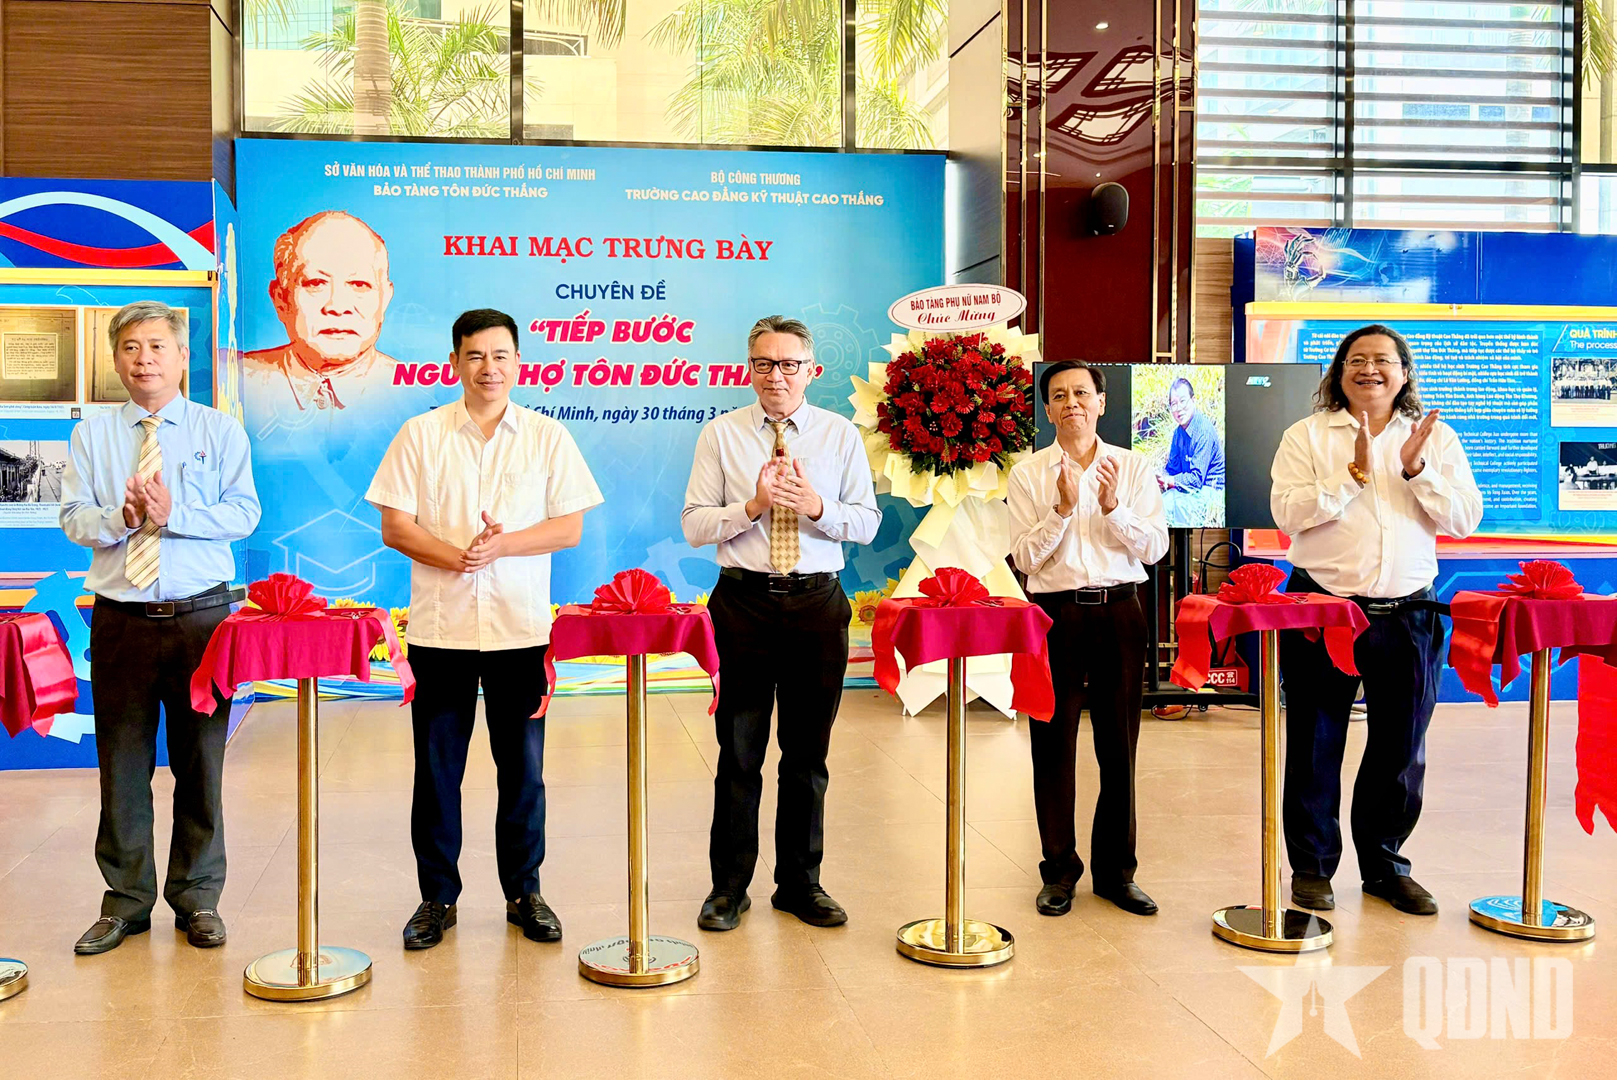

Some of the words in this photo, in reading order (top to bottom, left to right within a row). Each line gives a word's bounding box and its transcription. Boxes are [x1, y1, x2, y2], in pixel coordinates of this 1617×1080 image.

[324, 161, 341, 177] SỞ
[342, 163, 365, 178] VĂN
[368, 163, 391, 178] HÓA
[393, 163, 408, 178] VÀ
[410, 161, 432, 178] THỂ
[433, 166, 461, 179] THAO
[464, 164, 500, 180] THÀNH
[502, 163, 525, 180] PHỐ
[527, 163, 543, 180] HỒ
[545, 166, 564, 180] CHÍ
[566, 168, 596, 181] MINH
[710, 169, 725, 185] BỘ
[728, 169, 757, 185] CÔNG
[759, 172, 801, 186] THƯƠNG
[373, 182, 401, 196] BẢO
[403, 182, 440, 197] TÀNG
[441, 184, 470, 197] TÔN
[471, 183, 501, 198] ĐỨC
[503, 182, 548, 199] THẮNG
[625, 186, 679, 201] TRƯỜNG
[681, 189, 710, 202] CAO
[712, 186, 749, 203] ĐẲNG
[751, 188, 770, 203] KỸ
[771, 191, 809, 207] THUẬT
[811, 193, 840, 205] CAO
[841, 190, 884, 206] THẮNG
[443, 235, 519, 257] KHAI
[528, 236, 595, 264] MẠC
[602, 234, 706, 260] TRƯNG
[715, 233, 774, 261] BÀY
[555, 280, 634, 300] CHUYÊN
[640, 279, 666, 300] ĐỀ
[973, 294, 989, 305] NAM
[529, 309, 606, 343] “TIẾP
[611, 315, 694, 344] BƯỚC
[917, 312, 951, 325] Chúc
[1570, 340, 1585, 349] The
[517, 359, 566, 393] HỢ
[572, 358, 637, 387] TÔN
[640, 357, 699, 387] ĐỨC
[557, 406, 598, 423] Minh,
[602, 406, 639, 424] ngày
[643, 406, 660, 421] 30
[662, 406, 705, 424] tháng
[705, 407, 716, 422] 3
